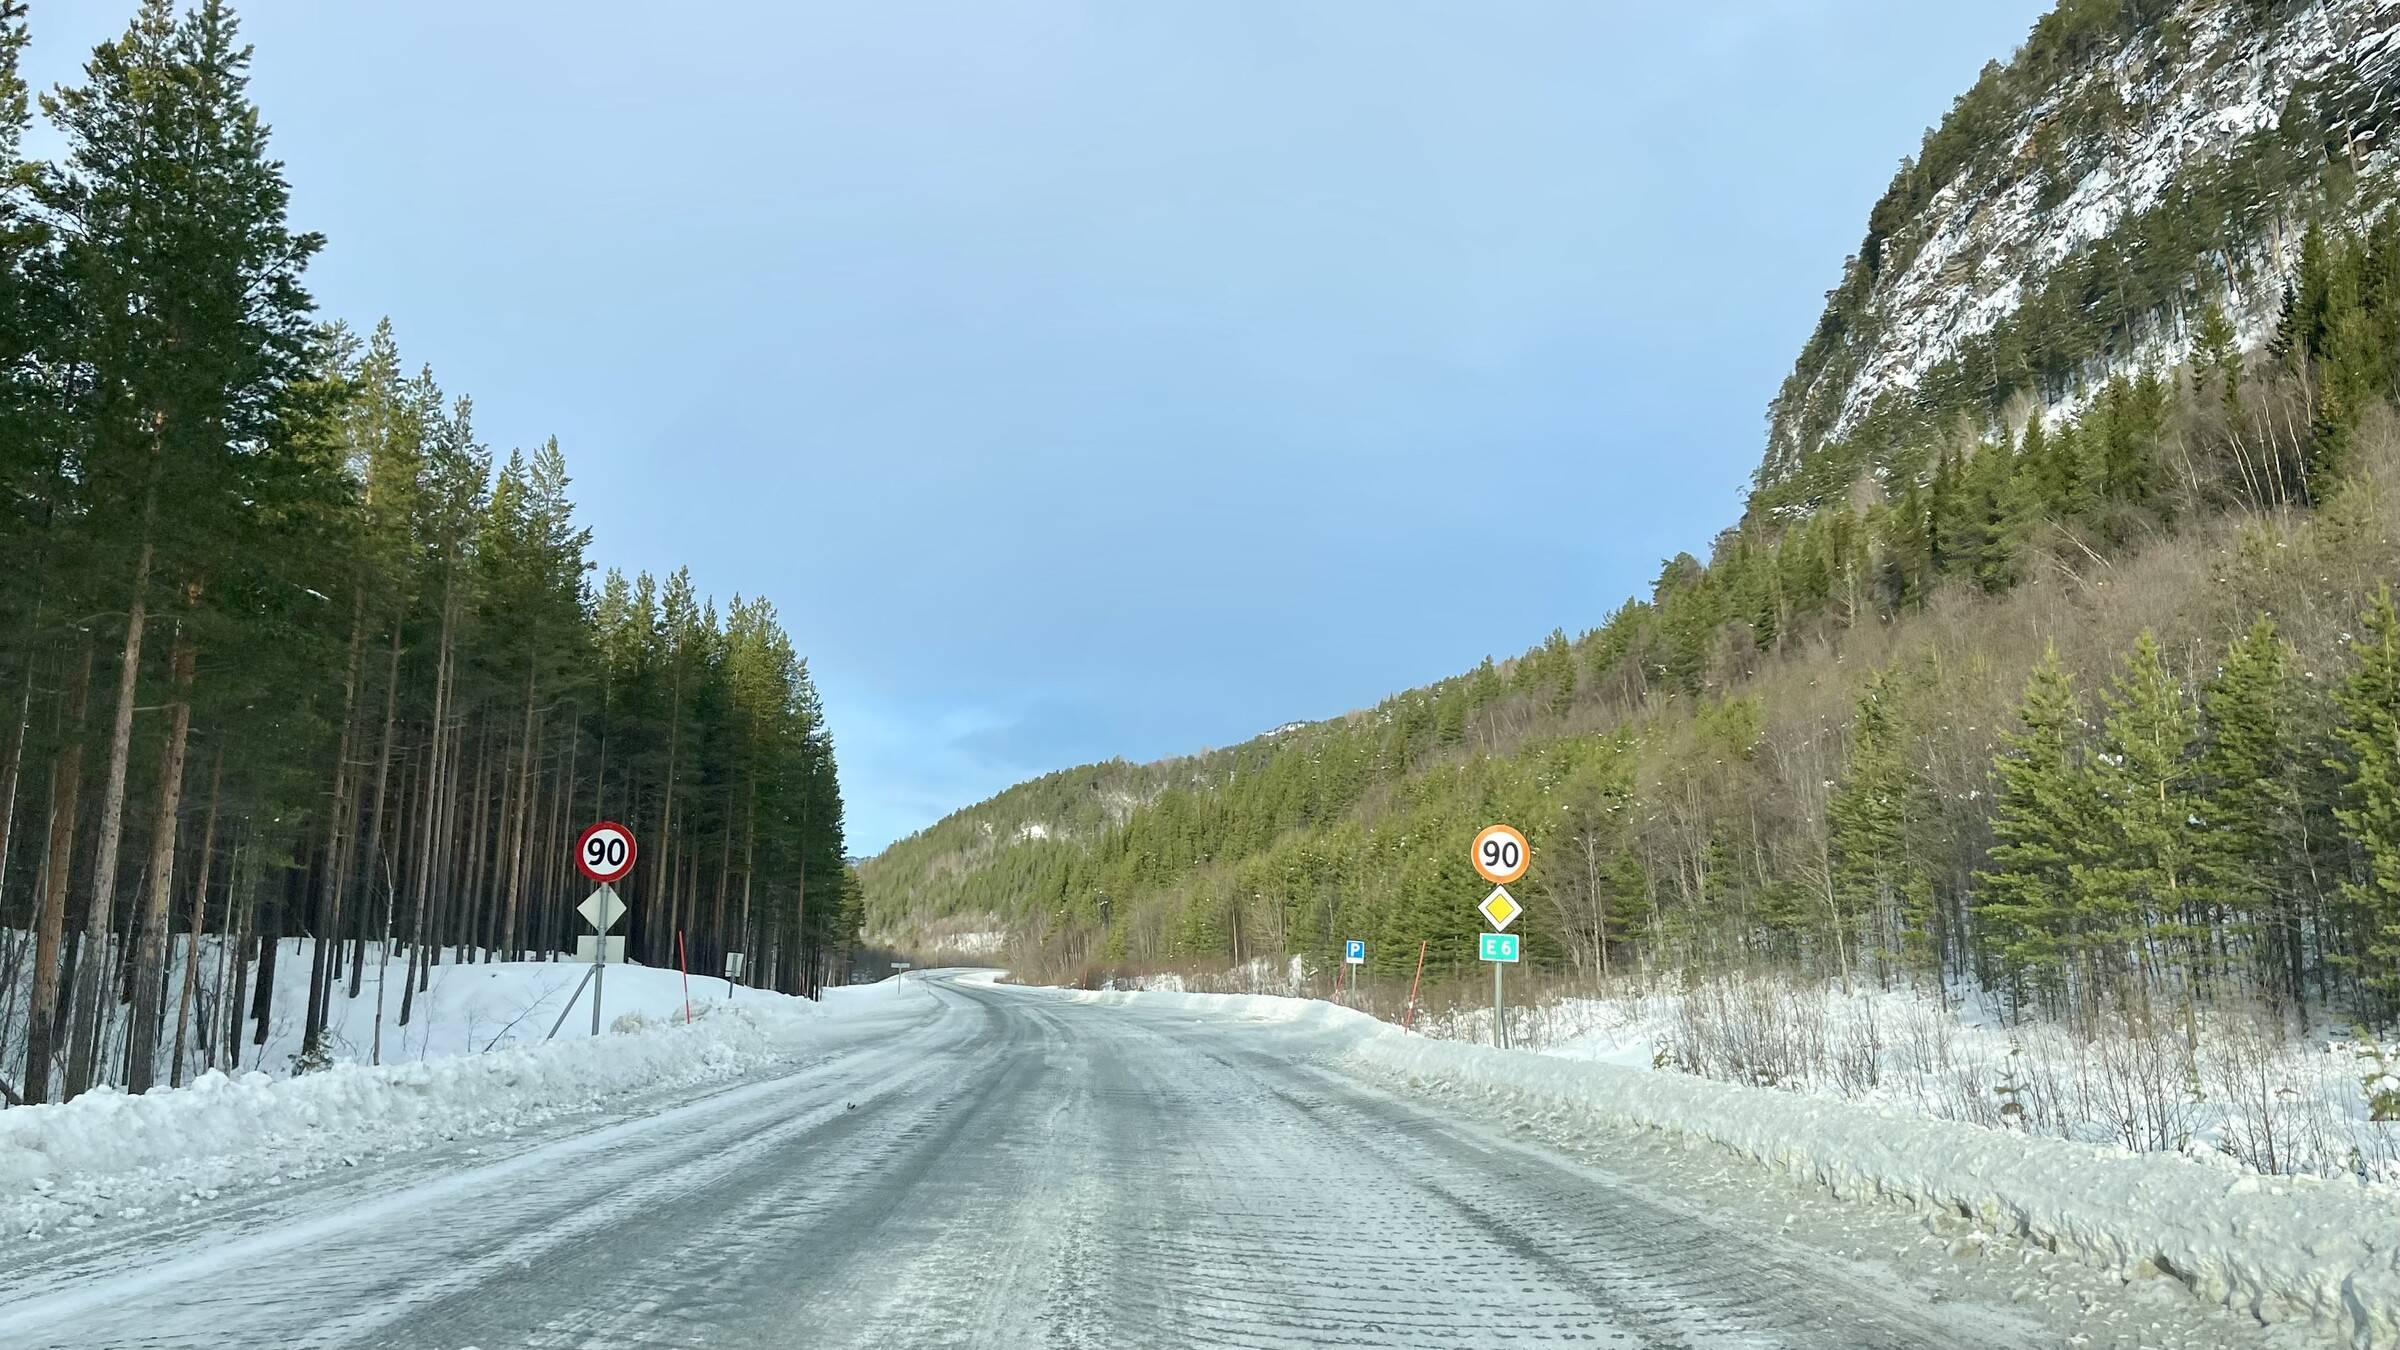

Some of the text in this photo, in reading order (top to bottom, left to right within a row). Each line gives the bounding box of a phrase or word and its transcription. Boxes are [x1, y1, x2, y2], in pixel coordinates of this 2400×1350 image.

[587, 838, 626, 866] 90
[1483, 840, 1519, 868] 90
[1350, 943, 1361, 957] P
[1487, 940, 1512, 955] E 6
